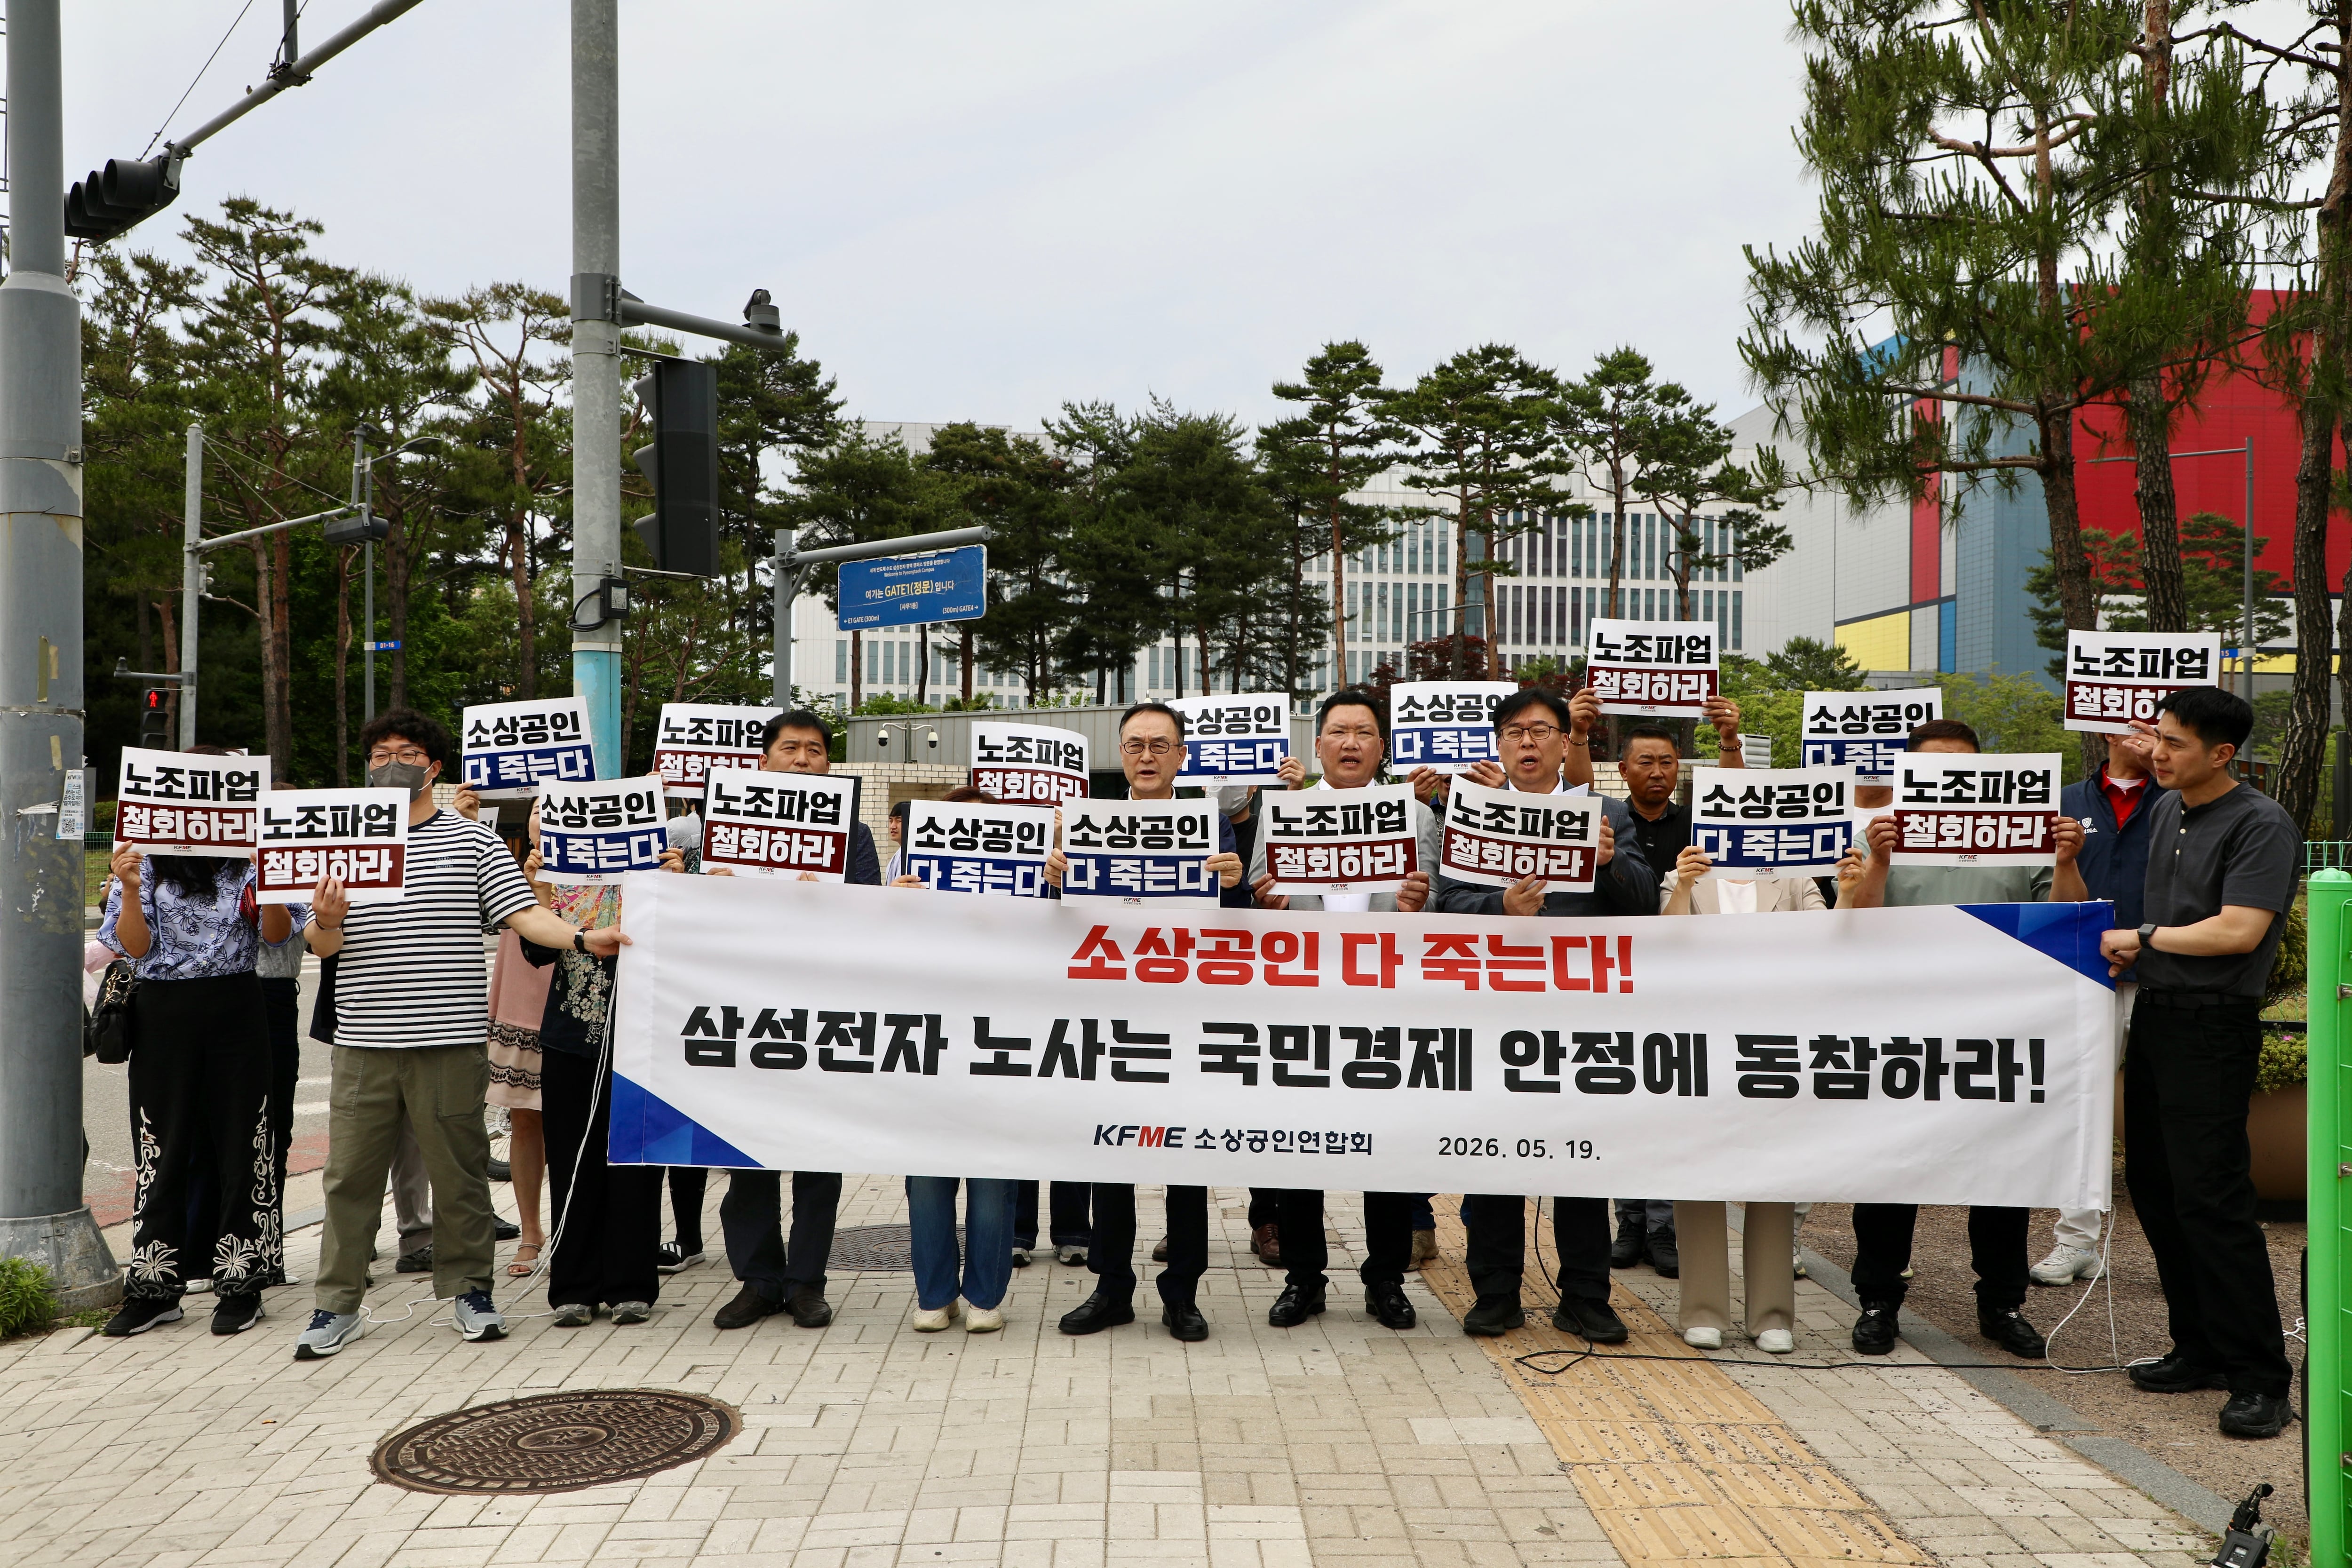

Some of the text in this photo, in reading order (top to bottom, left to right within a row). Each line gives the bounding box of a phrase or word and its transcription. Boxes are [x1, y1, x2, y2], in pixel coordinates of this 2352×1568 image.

[866, 580, 954, 599] 여기는 GATE1(정문) 입니다
[1594, 632, 1711, 664] 노조파업
[2073, 645, 2209, 679] 노조파업
[1593, 670, 1711, 702] 철회하라
[2074, 685, 2178, 719] 철회하
[468, 711, 581, 748] 소상공인
[1809, 702, 1933, 734] 소상공인
[977, 735, 1083, 772] 노조파업
[1200, 742, 1284, 771] 죽는다
[1395, 731, 1424, 759] 다
[1806, 744, 1836, 767] 다
[124, 763, 259, 802] 노조파업
[465, 749, 588, 786] 다 죽는다
[713, 783, 842, 825] 노조파업
[978, 771, 1082, 802] 철회하라
[1701, 781, 1844, 819] 소상공인
[1903, 769, 2050, 804] 노조파업
[122, 805, 256, 843] 철회하라
[263, 804, 397, 840] 노조파업
[541, 791, 657, 828] 소상공인
[1272, 800, 1406, 836] 노조파업
[1451, 792, 1589, 841] 노조파업
[711, 825, 835, 867] 철회하라
[915, 817, 1045, 855] 소상공인
[1070, 814, 1209, 849] 소상공인
[1697, 827, 1847, 861] 다 죽는다
[1903, 814, 2047, 848] 철회하라
[264, 849, 393, 885] 철회하라
[540, 833, 663, 869] 다 죽는다
[1275, 843, 1406, 878] 철회하라
[1450, 834, 1584, 878] 철회하라
[910, 860, 1045, 897] 다 죽는다
[1066, 858, 1213, 891] 다 죽는다
[1068, 925, 1634, 994] 소상공인 다 죽는다!
[680, 1005, 2045, 1104] 삼성전자 노사는 국민경제 안정에 동참하라!
[1094, 1124, 1374, 1158] KFME 소상공인연합회
[1438, 1137, 1601, 1161] 2026. 05. 19.
